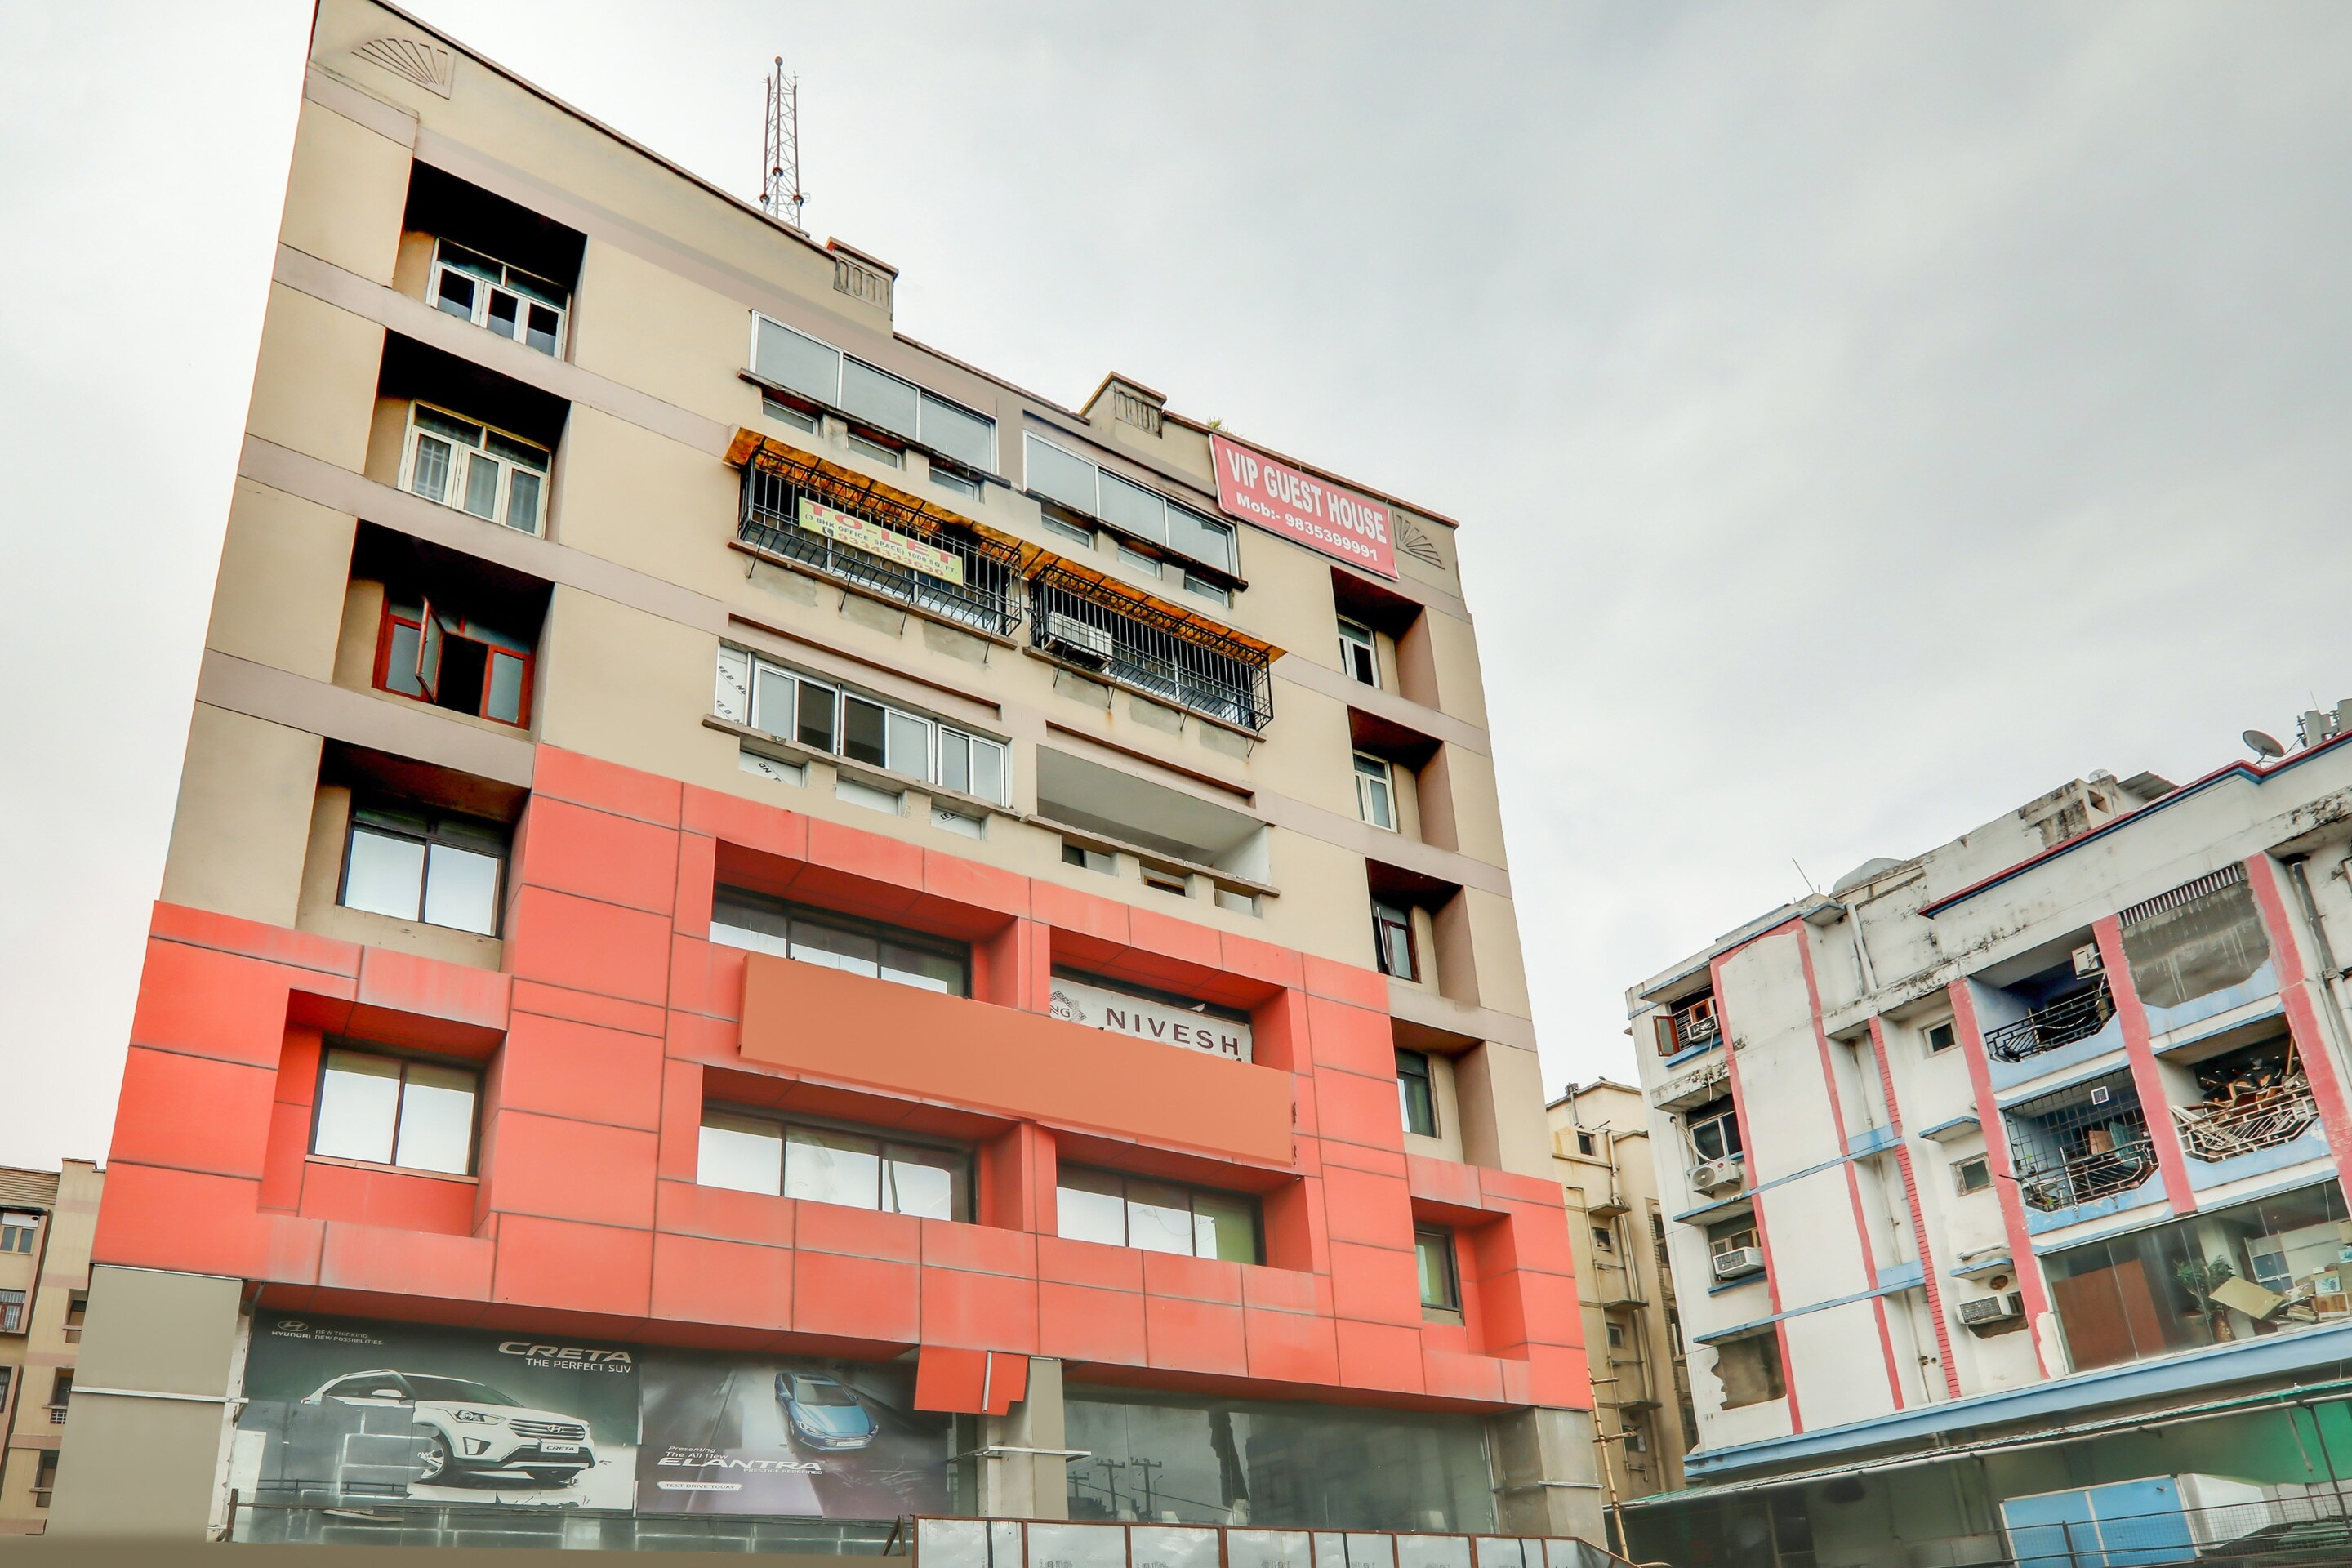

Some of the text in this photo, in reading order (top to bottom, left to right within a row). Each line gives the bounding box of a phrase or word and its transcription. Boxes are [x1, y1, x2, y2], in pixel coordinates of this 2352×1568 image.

[1226, 448, 1387, 544] VIP GUEST HOUSE
[804, 500, 956, 564] TO-LET
[817, 517, 835, 529] BHK
[838, 525, 869, 541] OFFICE
[874, 538, 904, 555] SPACE)
[907, 551, 927, 563] 1000
[1236, 492, 1378, 561] Mob:- 9835399991
[1106, 1007, 1239, 1056] NIVESH
[271, 1330, 311, 1339] HYUNDAI
[498, 1341, 632, 1364] CRETA
[526, 1357, 632, 1374] THE PERFECT SUV
[657, 1457, 822, 1471] ELANTRA
[667, 1446, 716, 1454] Presenting
